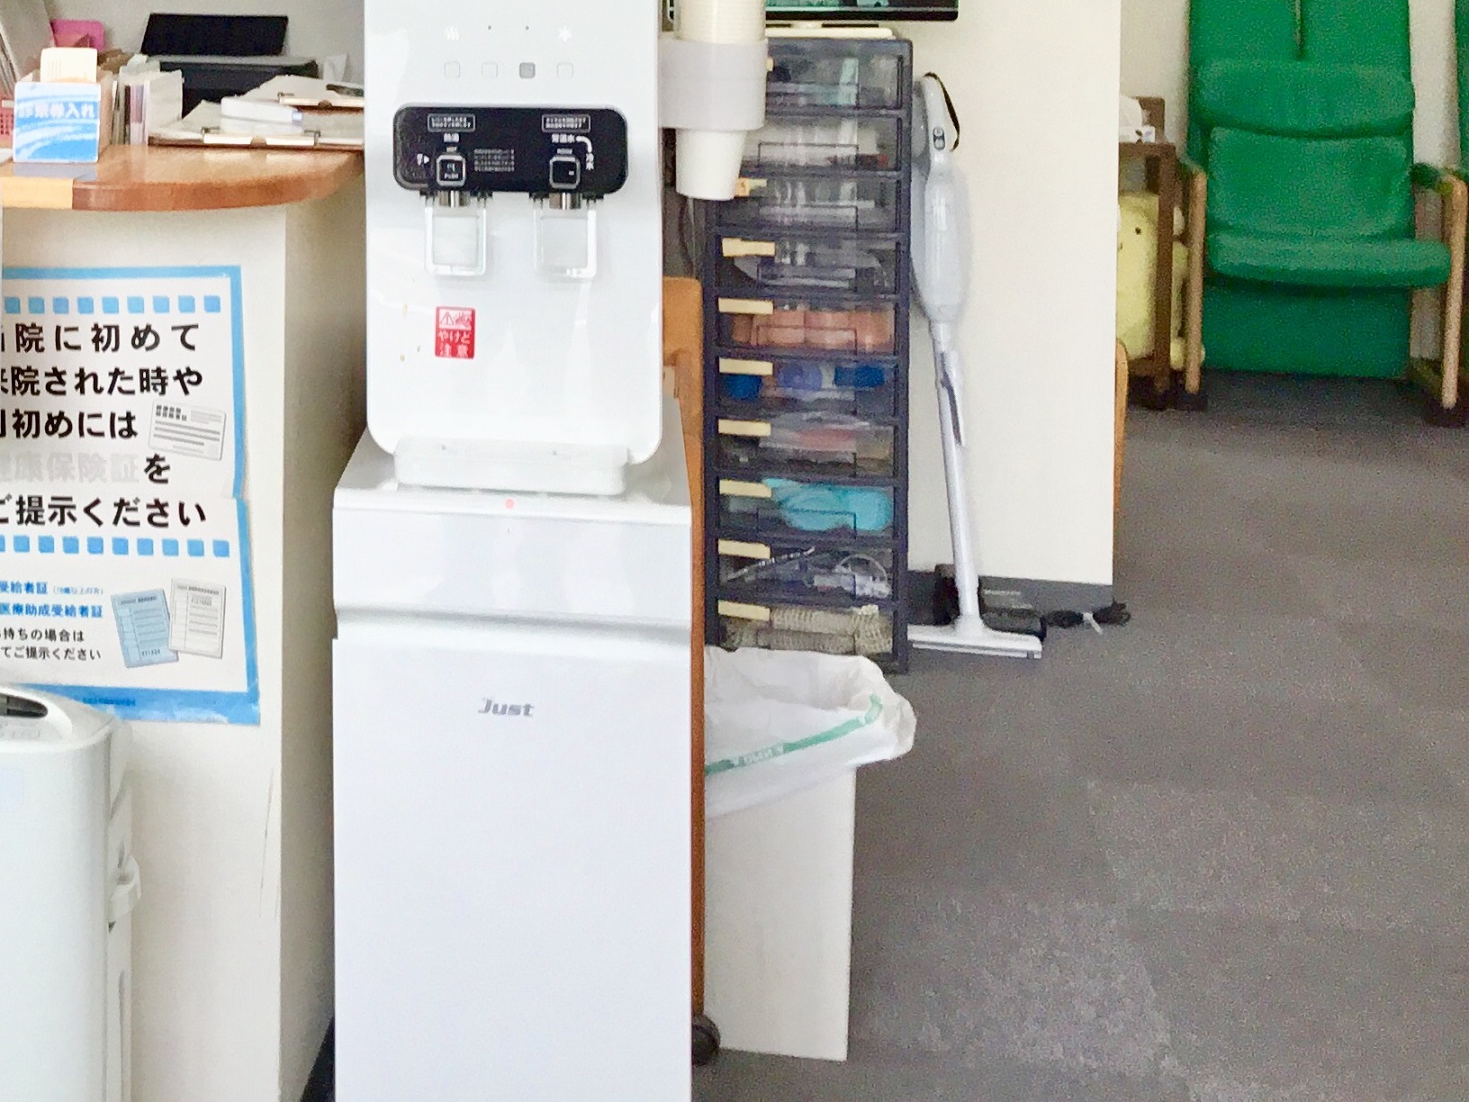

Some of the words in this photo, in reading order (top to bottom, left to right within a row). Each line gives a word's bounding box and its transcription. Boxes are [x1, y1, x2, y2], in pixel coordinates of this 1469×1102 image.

[0, 323, 200, 353] 院に初めて
